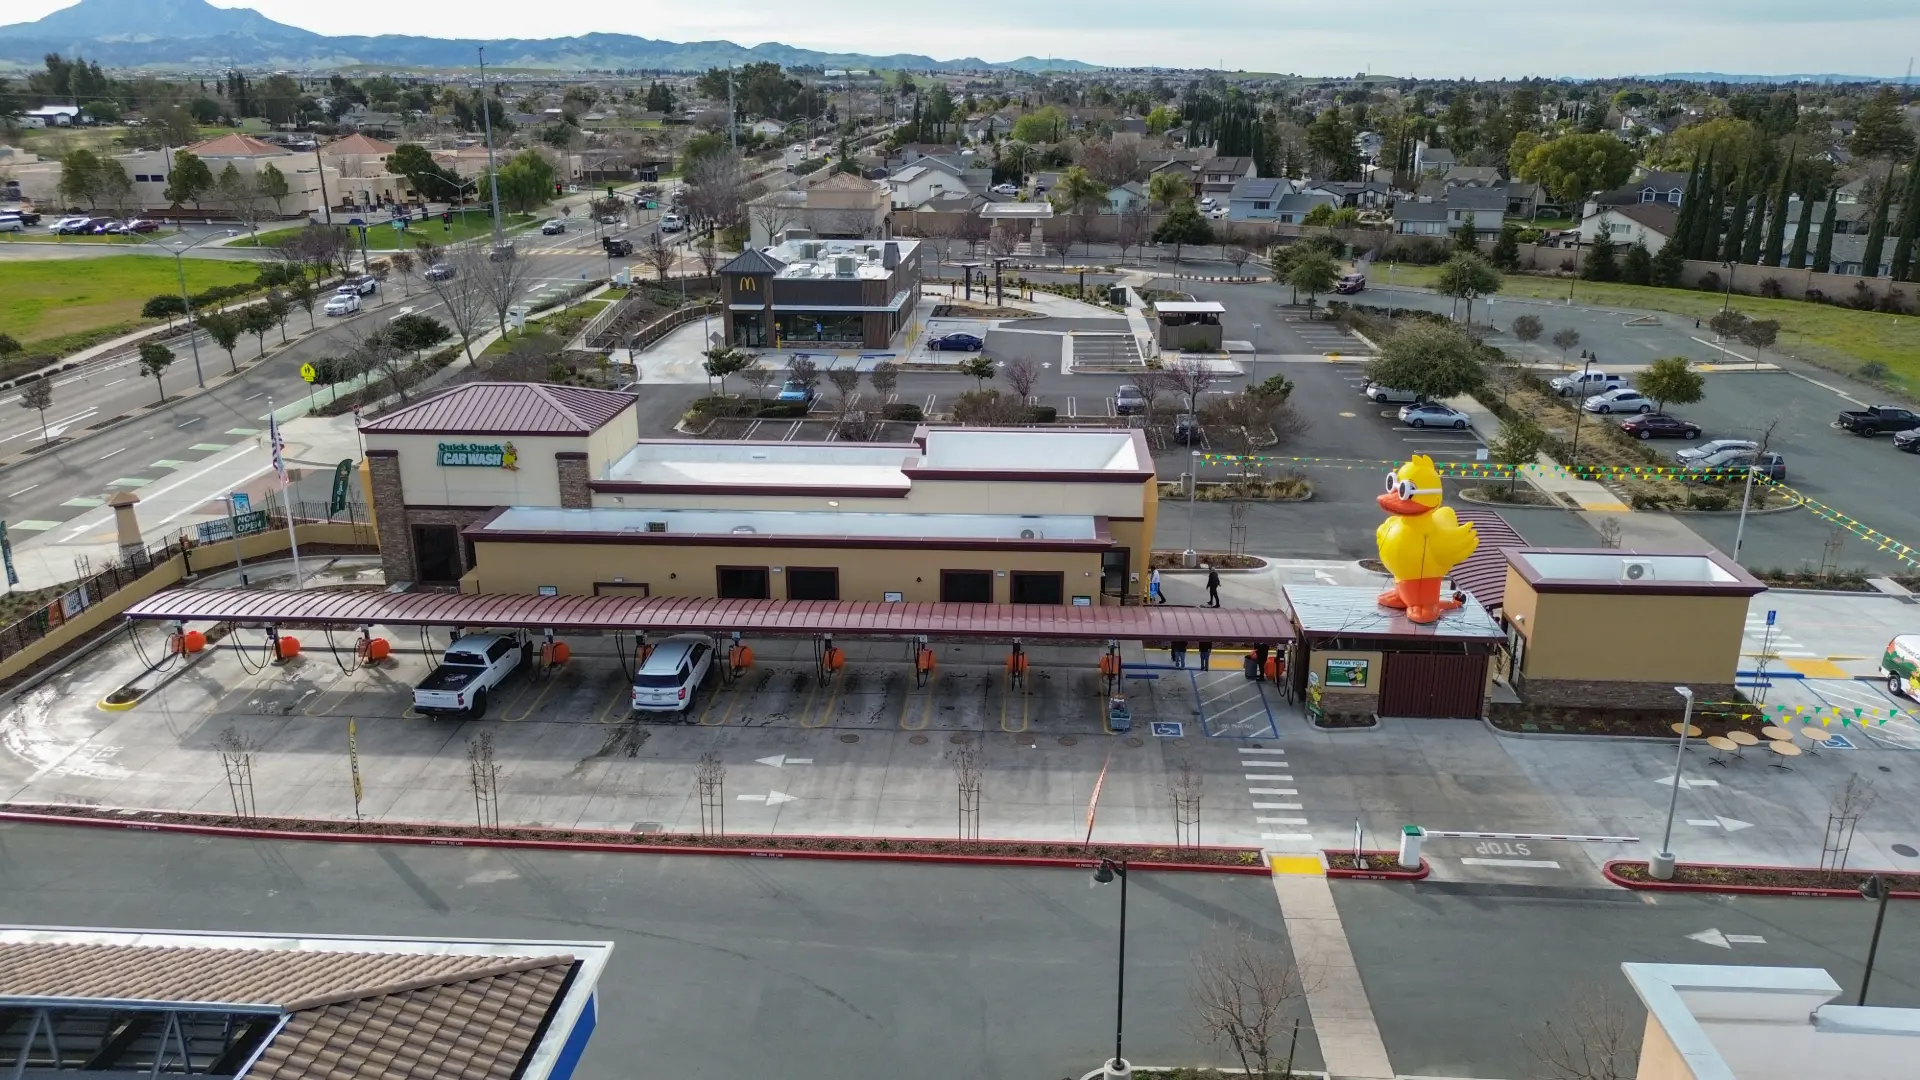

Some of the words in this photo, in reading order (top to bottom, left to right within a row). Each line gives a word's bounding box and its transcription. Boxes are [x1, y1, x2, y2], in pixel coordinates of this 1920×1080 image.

[438, 443, 468, 453] Quick
[469, 443, 502, 453] Quack
[443, 452, 467, 465] CAR
[467, 453, 502, 466] WASH
[237, 512, 258, 524] NOW
[237, 520, 262, 532] OPEN
[1475, 841, 1531, 856] STOP
